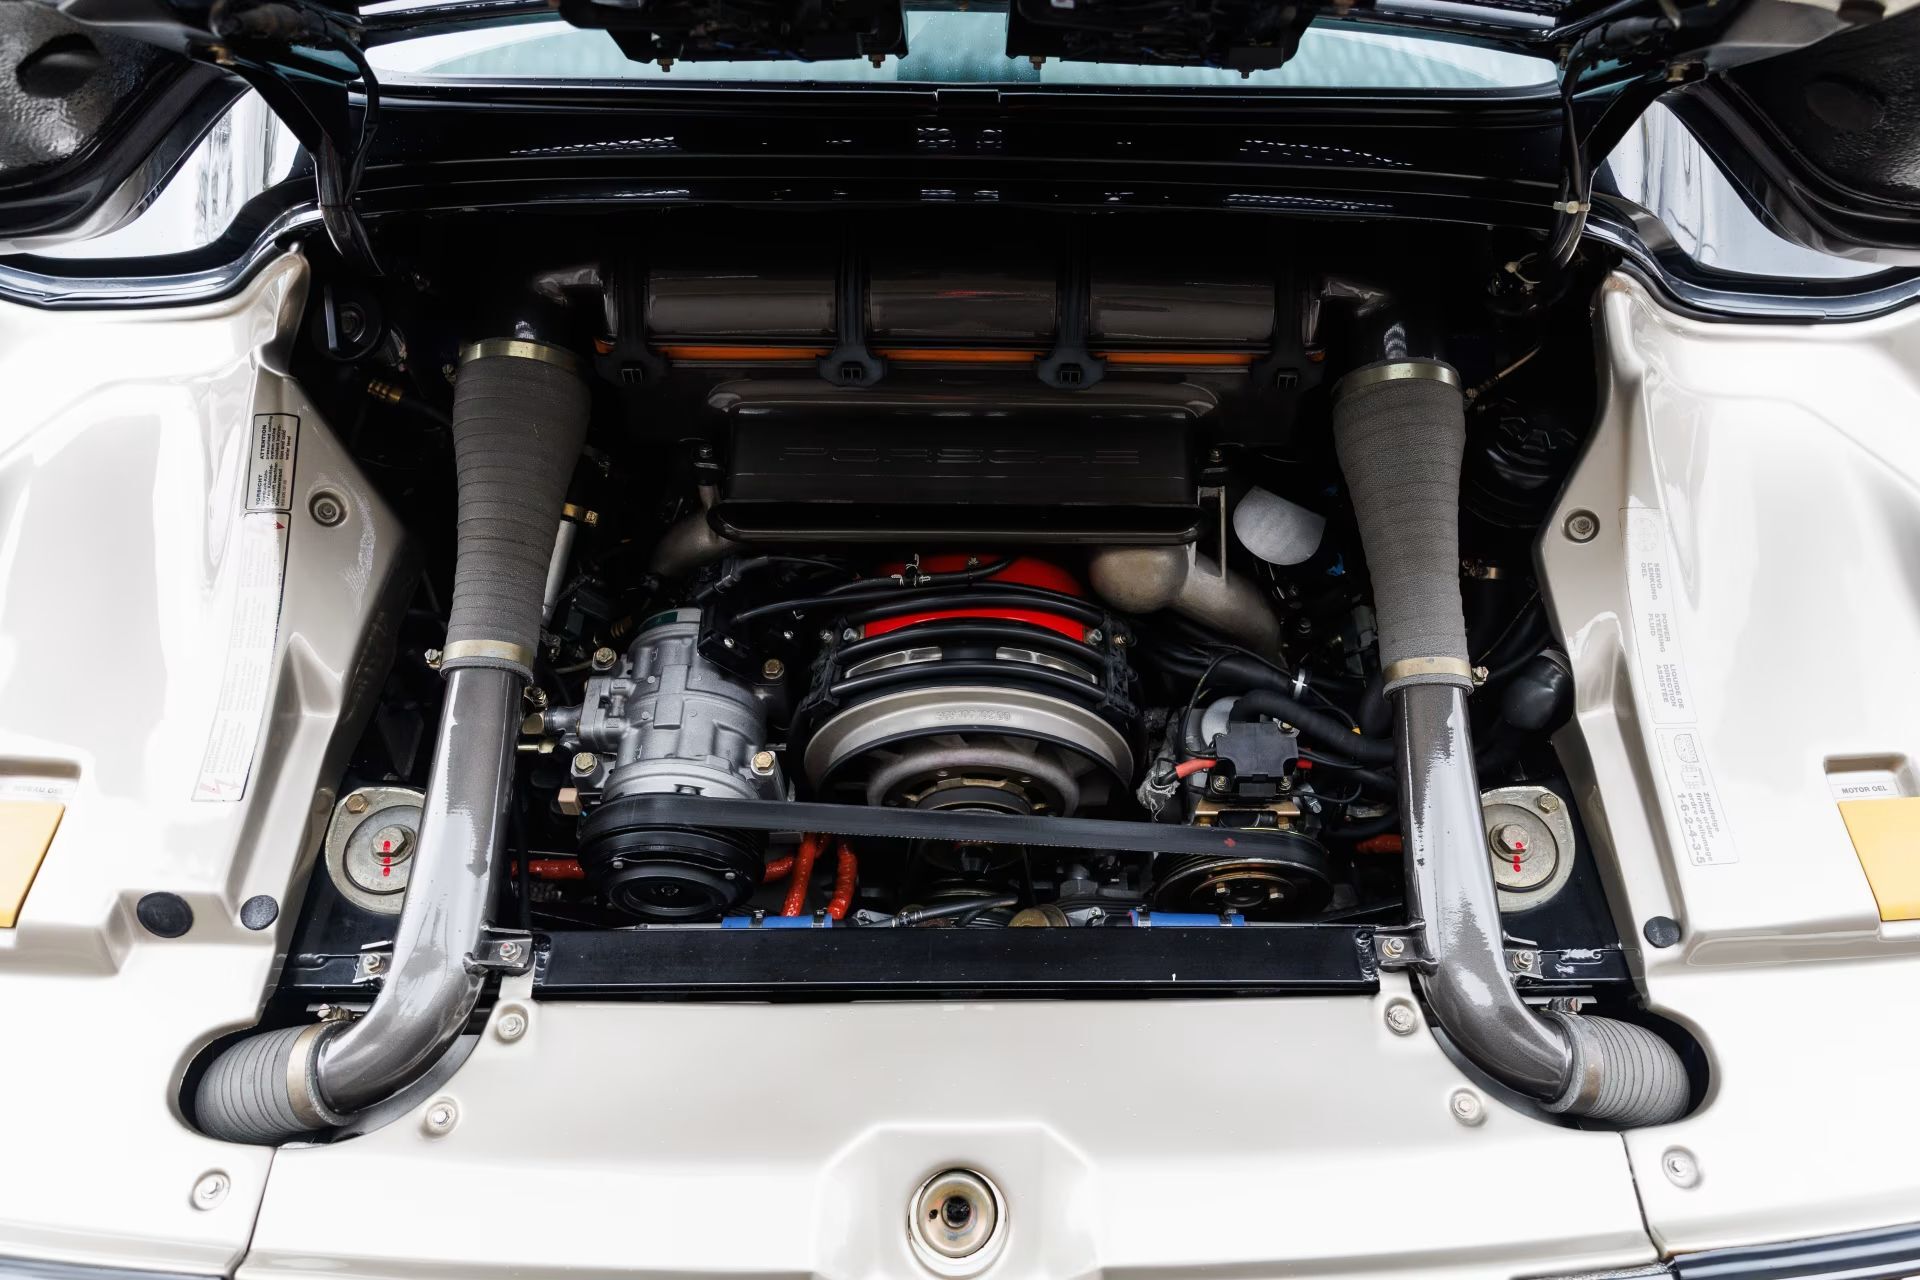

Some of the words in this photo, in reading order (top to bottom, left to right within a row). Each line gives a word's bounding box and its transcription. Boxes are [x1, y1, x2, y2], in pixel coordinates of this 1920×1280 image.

[776, 447, 1141, 464] PORSCHE
[1647, 562, 1657, 600] LENKUNG
[1654, 563, 1662, 588] SERVO
[1648, 613, 1656, 636] FLUID
[1655, 613, 1665, 652] STEERING
[1661, 613, 1671, 642] POWER
[1662, 664, 1677, 707] DIRECTION
[1670, 664, 1681, 695] LIQUIDE
[1677, 698, 1684, 709] DE
[1842, 786, 1870, 794] MOTOR
[1678, 793, 1705, 863] 1-6-2-4-3-5
[1688, 793, 1698, 815] ordre
[1696, 818, 1713, 861] d'allumage
[1696, 793, 1706, 813] firing
[1704, 817, 1714, 838] order
[1704, 792, 1720, 832] Zündfolge
